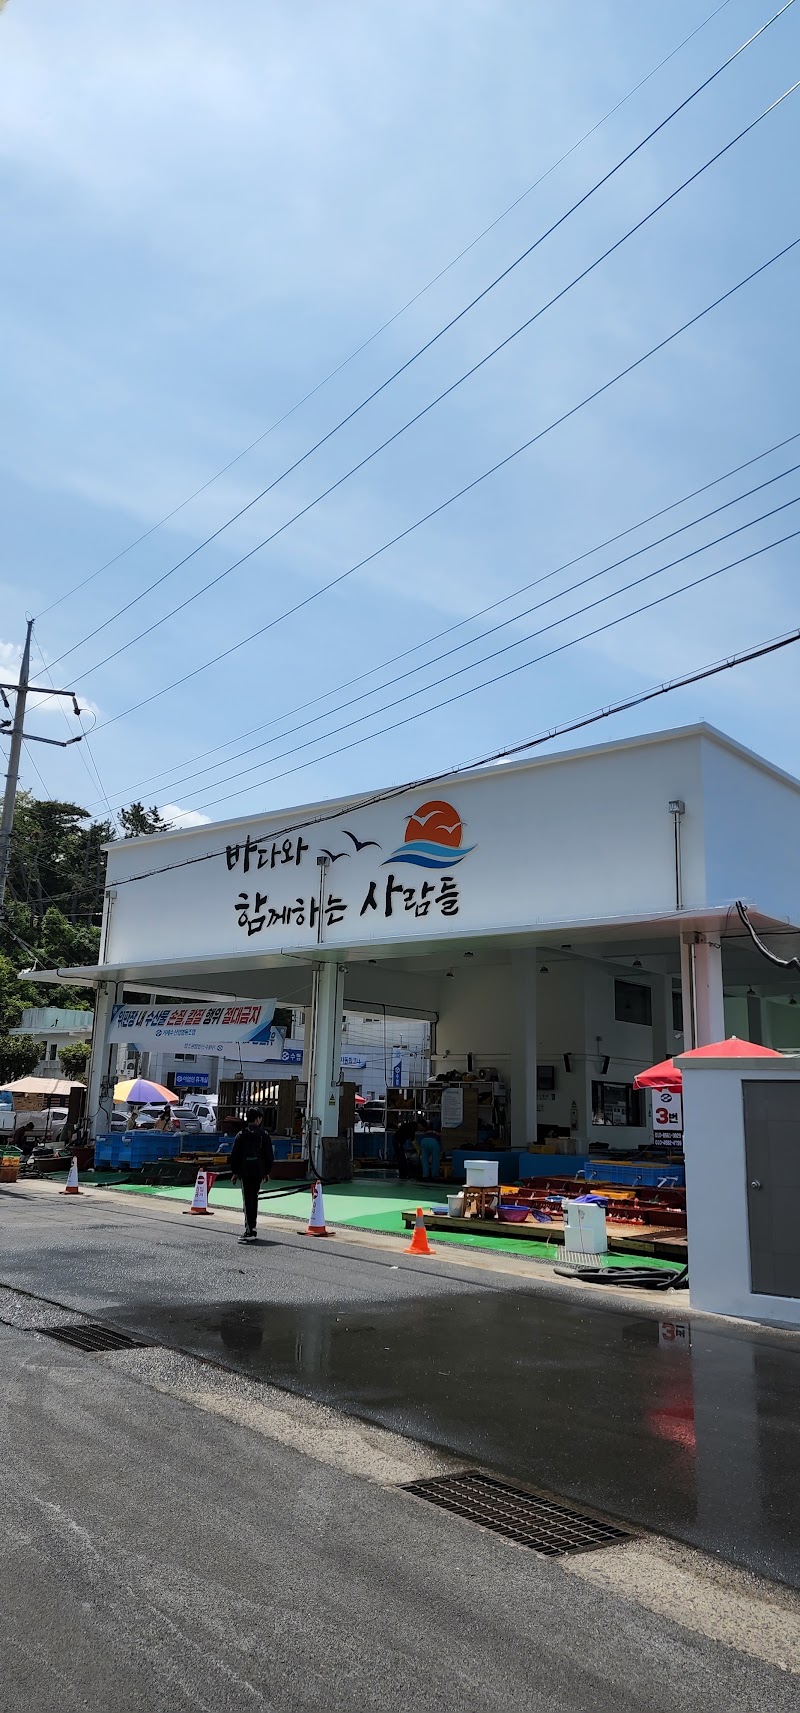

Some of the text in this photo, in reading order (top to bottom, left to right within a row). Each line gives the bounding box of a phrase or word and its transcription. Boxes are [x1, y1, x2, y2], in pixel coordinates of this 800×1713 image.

[225, 835, 309, 873] 바다와
[234, 874, 460, 936] 함께하는 사람들
[145, 1009, 171, 1026] 수산물
[203, 1007, 225, 1024] 행위
[221, 1005, 262, 1024] 절대금지
[655, 1107, 678, 1124] 3번
